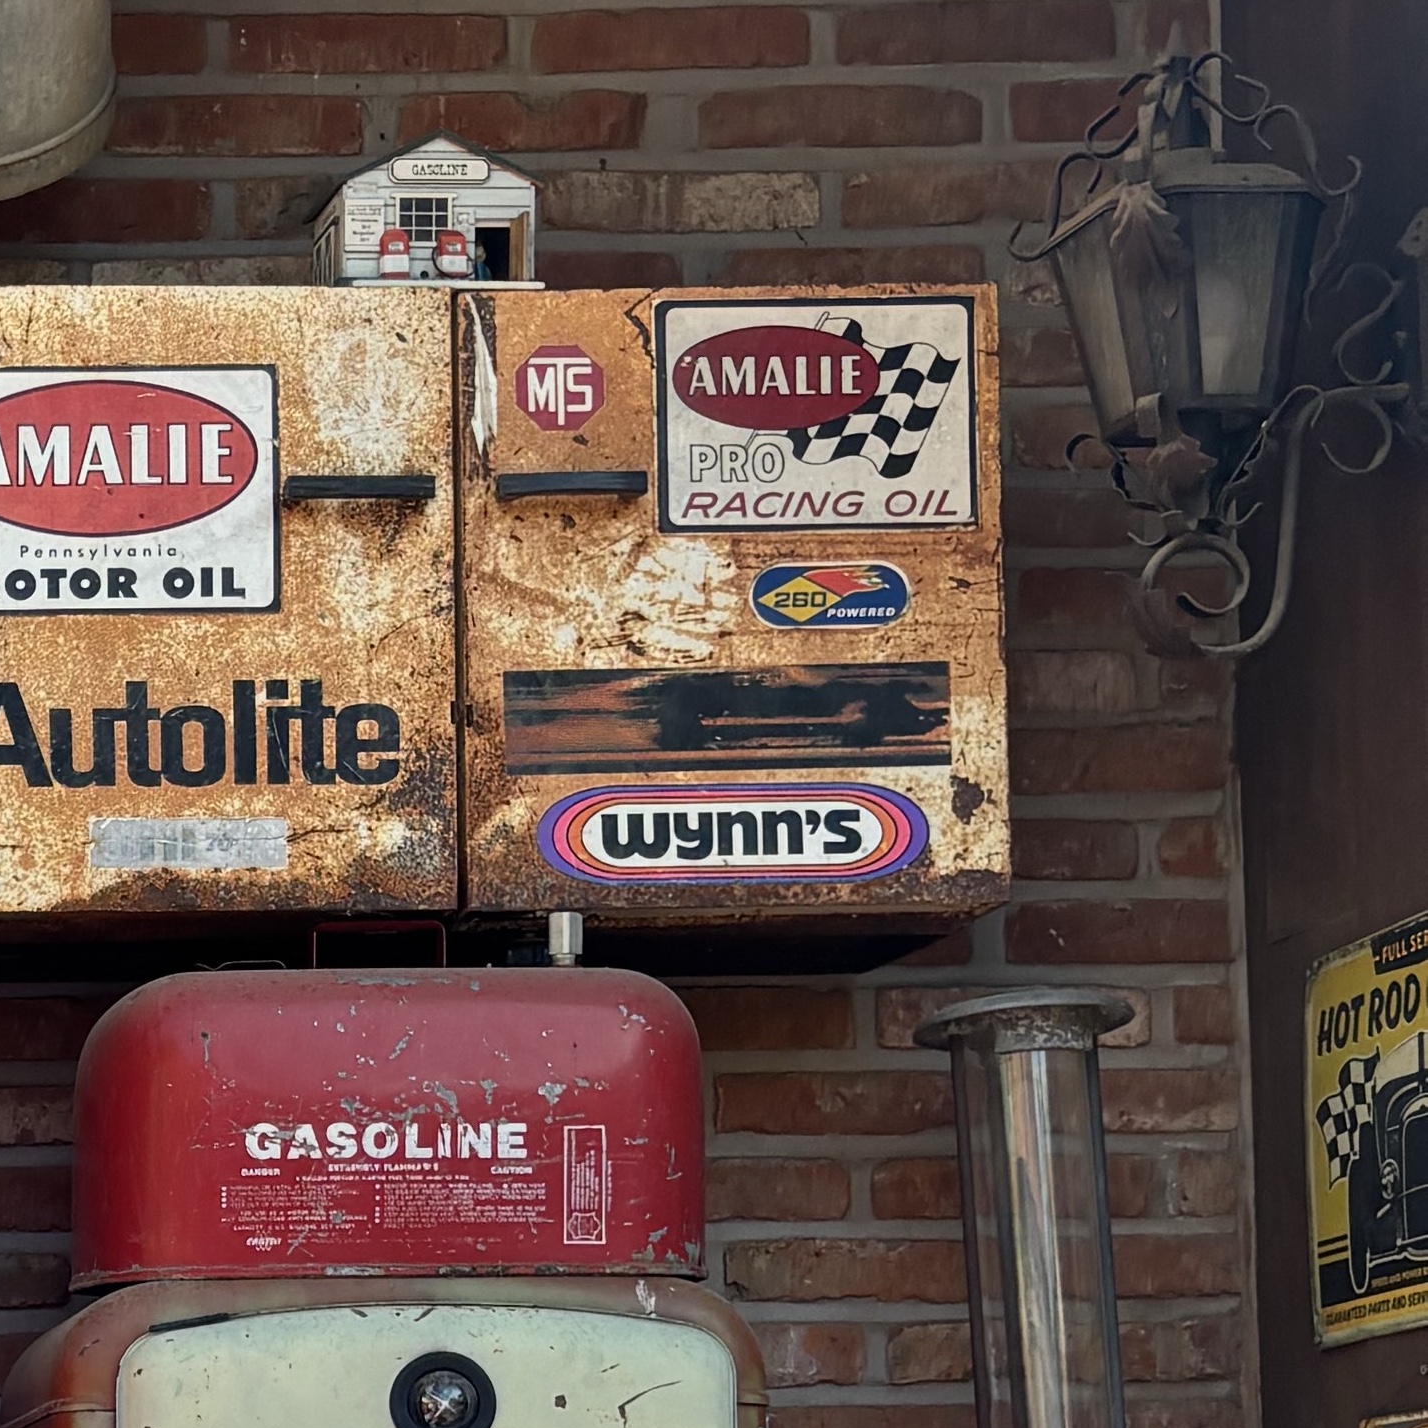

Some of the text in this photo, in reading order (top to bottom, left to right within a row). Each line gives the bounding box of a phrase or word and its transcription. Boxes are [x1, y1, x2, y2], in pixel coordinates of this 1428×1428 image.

[412, 164, 468, 176] GASOLINE
[688, 355, 863, 396] AMALIE
[689, 442, 785, 483] PRO
[681, 489, 960, 519] RACING OIL
[20, 544, 178, 560] Pennsylvania
[162, 567, 246, 599] OIL
[773, 591, 826, 608] 260
[826, 606, 896, 618] POWERED
[1382, 938, 1408, 964] FULL
[1317, 973, 1421, 1057] HOT ROD
[245, 1122, 527, 1160] GASOLINE
